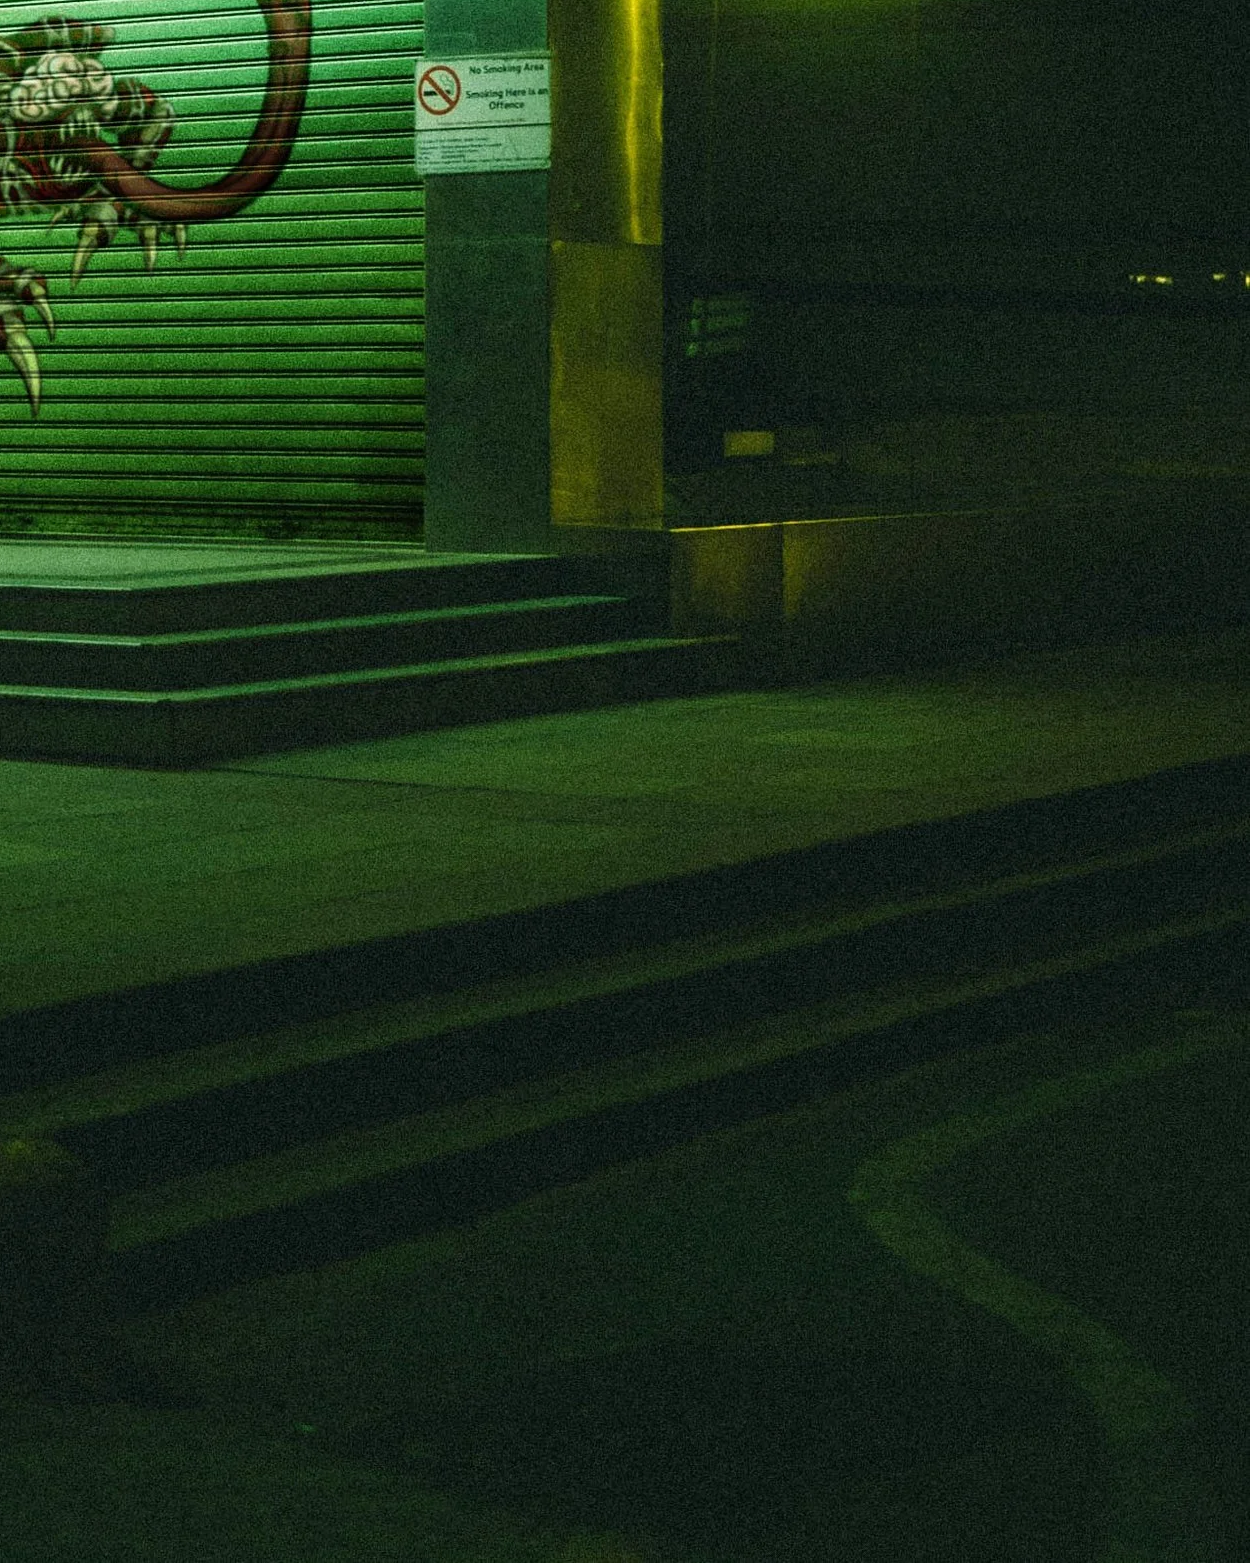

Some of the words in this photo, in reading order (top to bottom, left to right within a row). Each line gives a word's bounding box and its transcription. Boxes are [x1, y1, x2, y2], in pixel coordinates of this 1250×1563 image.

[469, 66, 481, 75] No
[483, 64, 521, 75] Smoking
[524, 63, 544, 71] Area
[466, 89, 503, 100] Smoking
[488, 100, 525, 110] Offence
